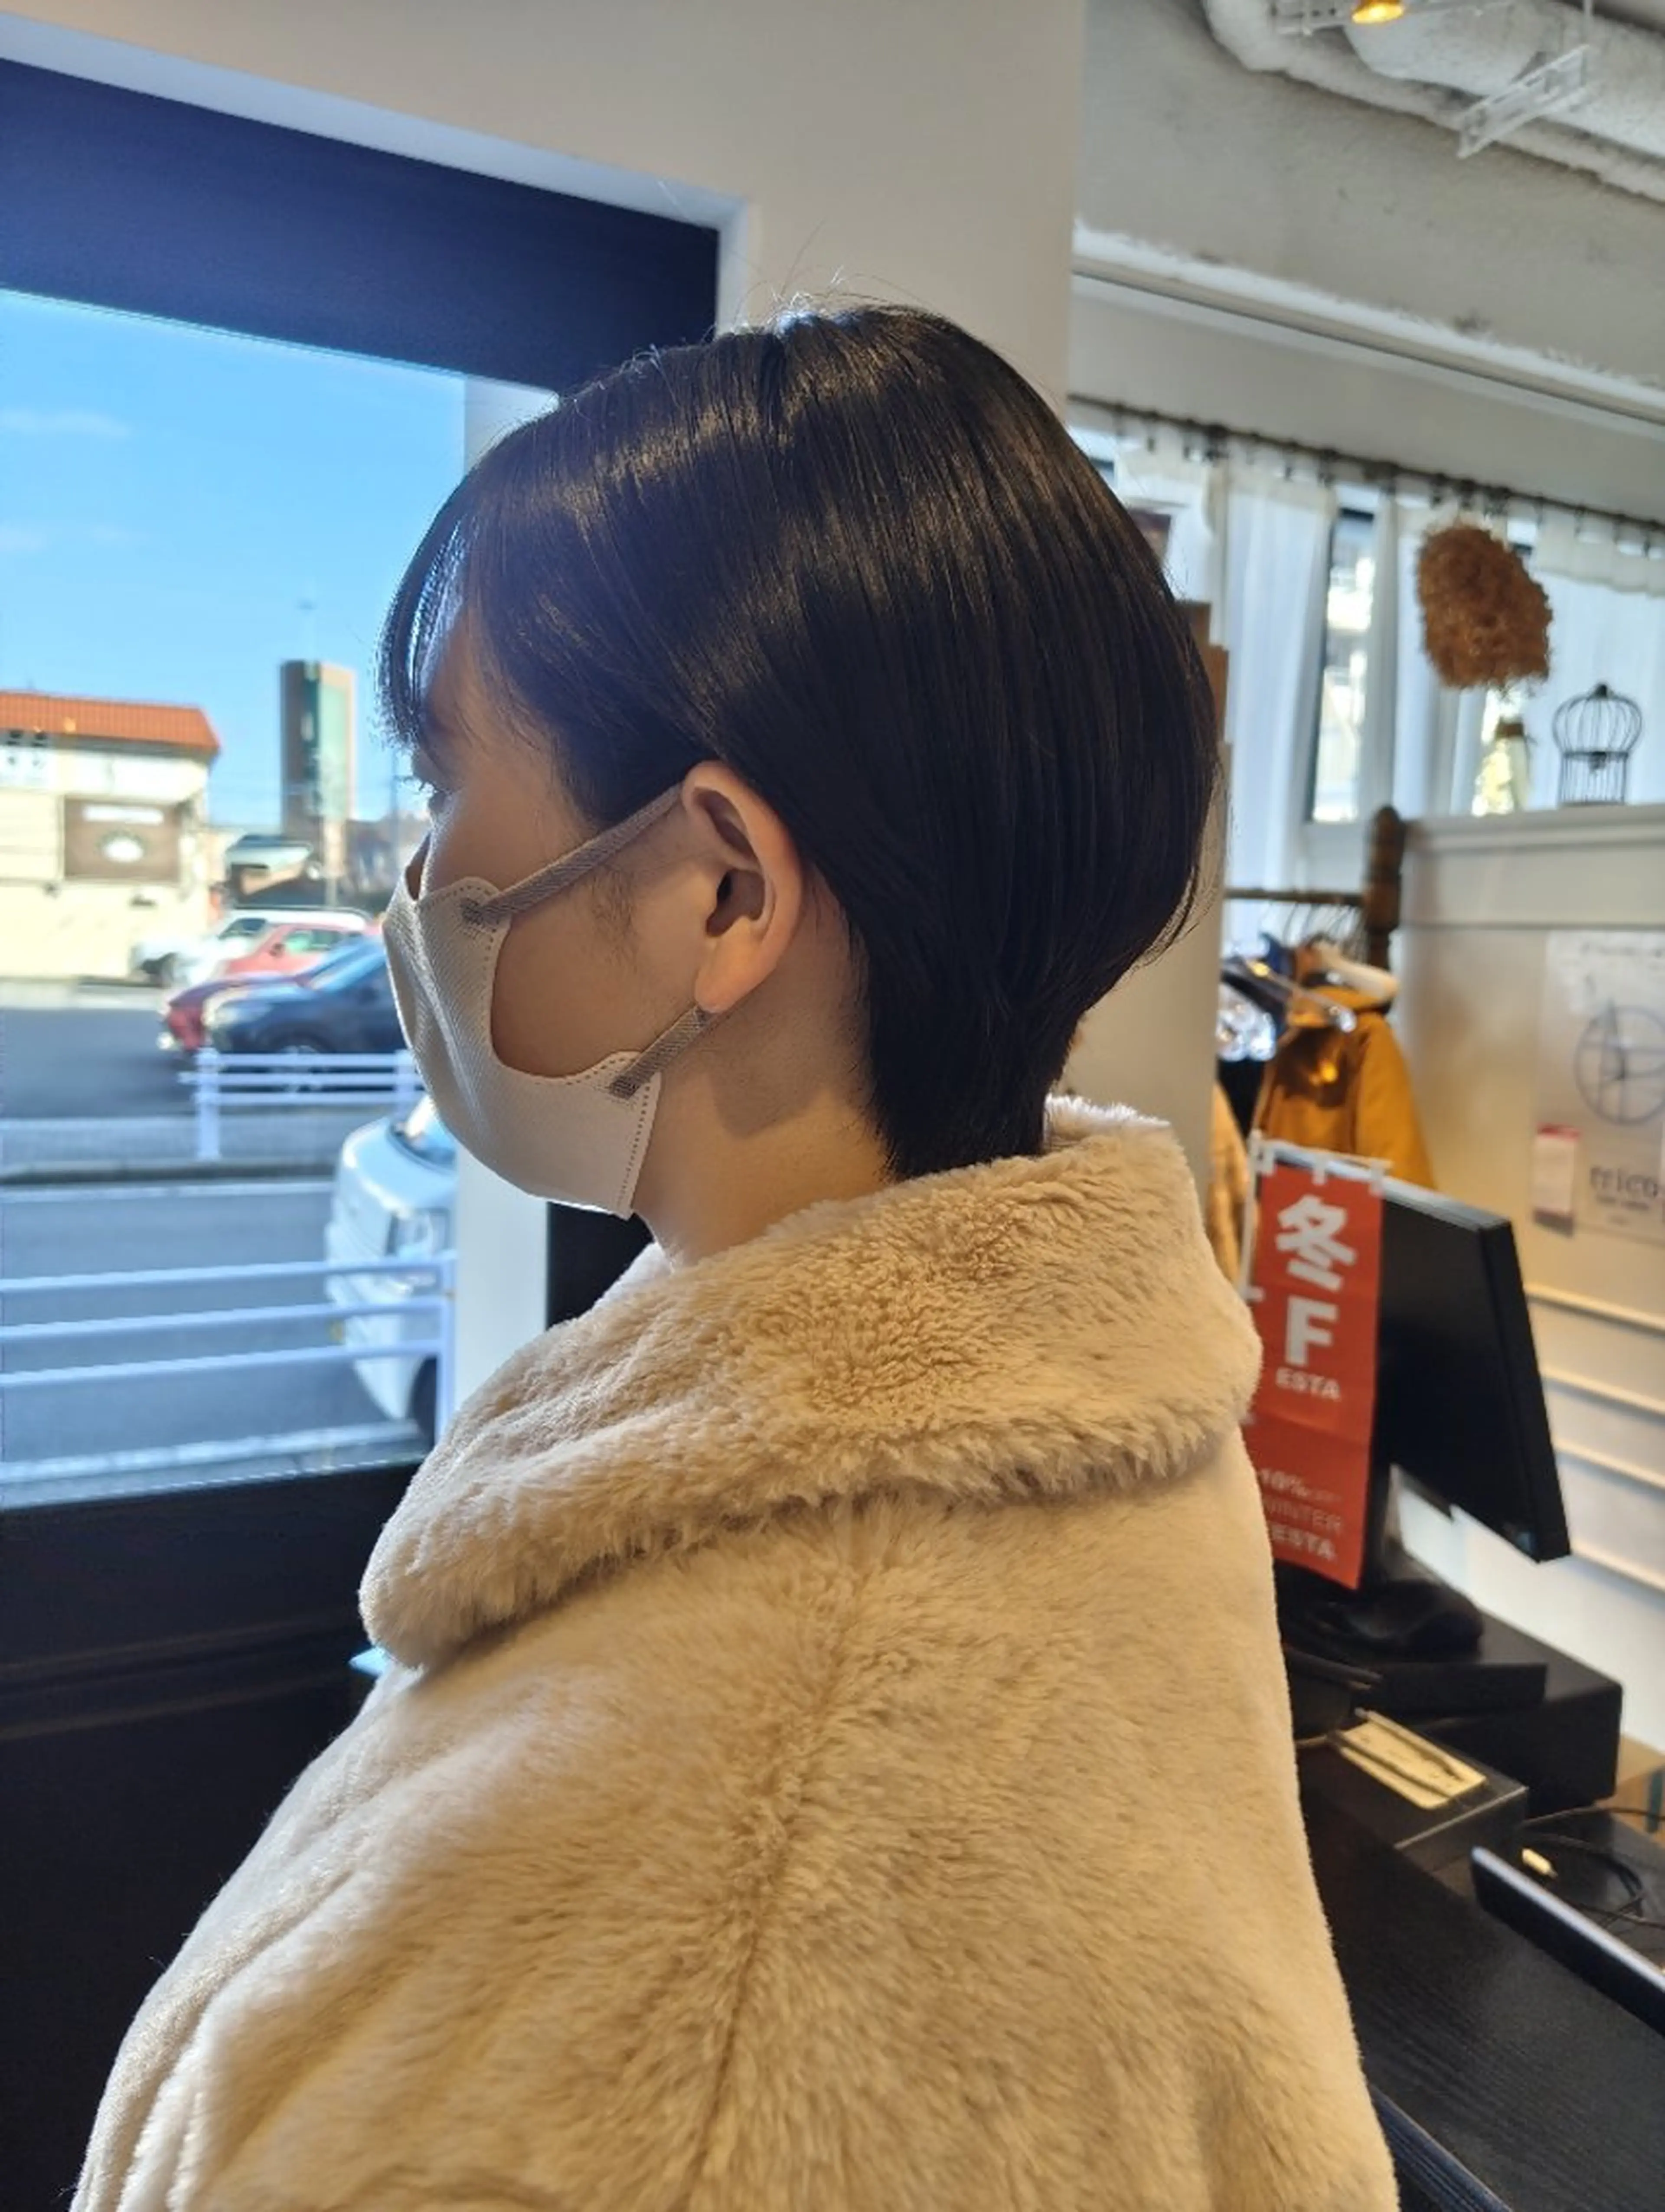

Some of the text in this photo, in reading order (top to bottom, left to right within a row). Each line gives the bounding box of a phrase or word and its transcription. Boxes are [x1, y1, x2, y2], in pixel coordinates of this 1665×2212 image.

[1275, 1194, 1355, 1291] 冬
[1275, 1367, 1341, 1401] ESTA
[1268, 1521, 1337, 1562] ESTA
